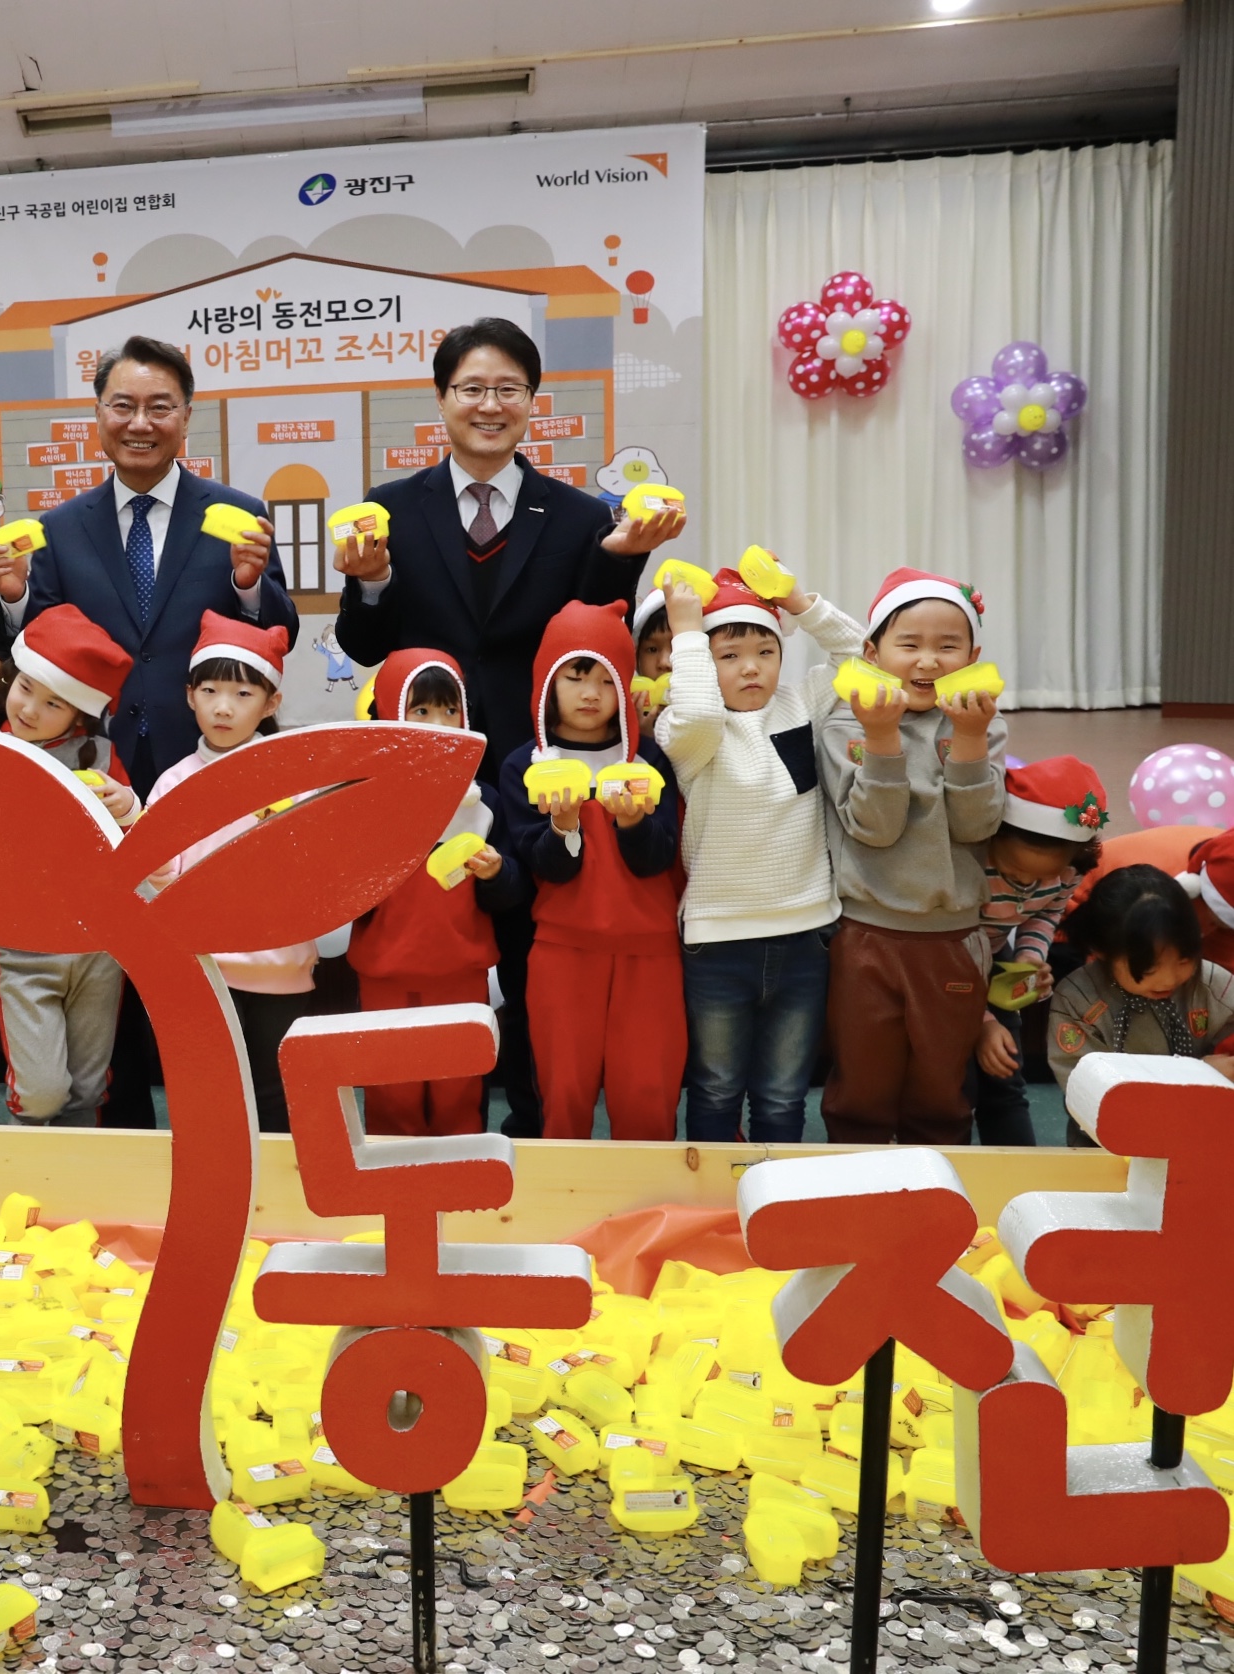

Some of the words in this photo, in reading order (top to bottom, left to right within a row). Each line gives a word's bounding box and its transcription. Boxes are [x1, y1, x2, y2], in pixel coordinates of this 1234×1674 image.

[536, 170, 590, 188] World
[595, 167, 649, 184] Vision
[343, 174, 416, 196] 광진구
[24, 201, 67, 219] 국공립
[71, 197, 128, 217] 어린이집
[133, 192, 176, 211] 연합회
[187, 303, 262, 335] 사랑의
[272, 295, 403, 329] 동전모으기
[204, 335, 325, 374] 아침머꼬
[273, 423, 295, 432] 광진구
[296, 422, 318, 431] 국공립
[62, 431, 90, 440] 어린이집
[270, 431, 298, 441] 어린이집
[299, 430, 321, 439] 연합회
[39, 453, 67, 463] 어린이집
[397, 456, 427, 466] 어린이집
[66, 477, 93, 487] 어린이집
